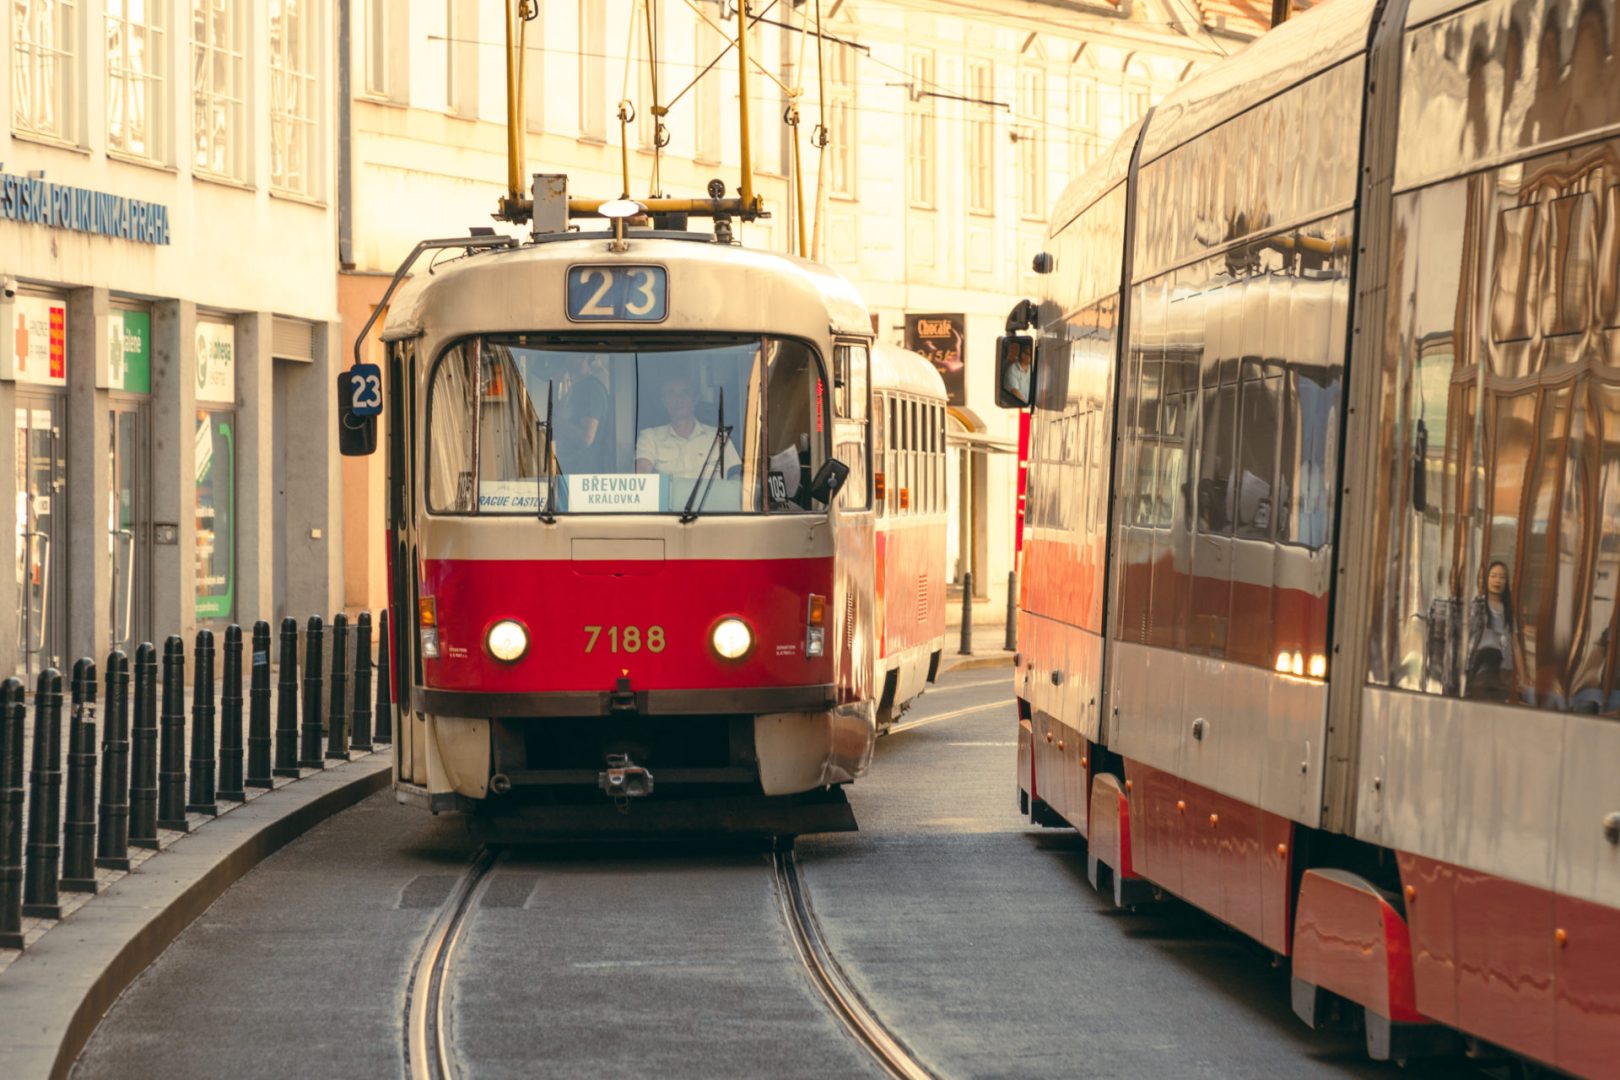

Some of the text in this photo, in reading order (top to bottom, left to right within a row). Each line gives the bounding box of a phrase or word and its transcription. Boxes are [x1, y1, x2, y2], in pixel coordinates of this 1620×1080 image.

[50, 183, 130, 239] POLIKLINIKA
[129, 199, 170, 245] PRAHA
[578, 267, 656, 315] 23
[351, 374, 381, 408] 23
[581, 476, 646, 492] BŘEVNOV
[768, 475, 786, 501] 105
[479, 496, 510, 506] RAGUE
[588, 493, 640, 504] KRÁLOVKA
[583, 625, 666, 653] 7188
